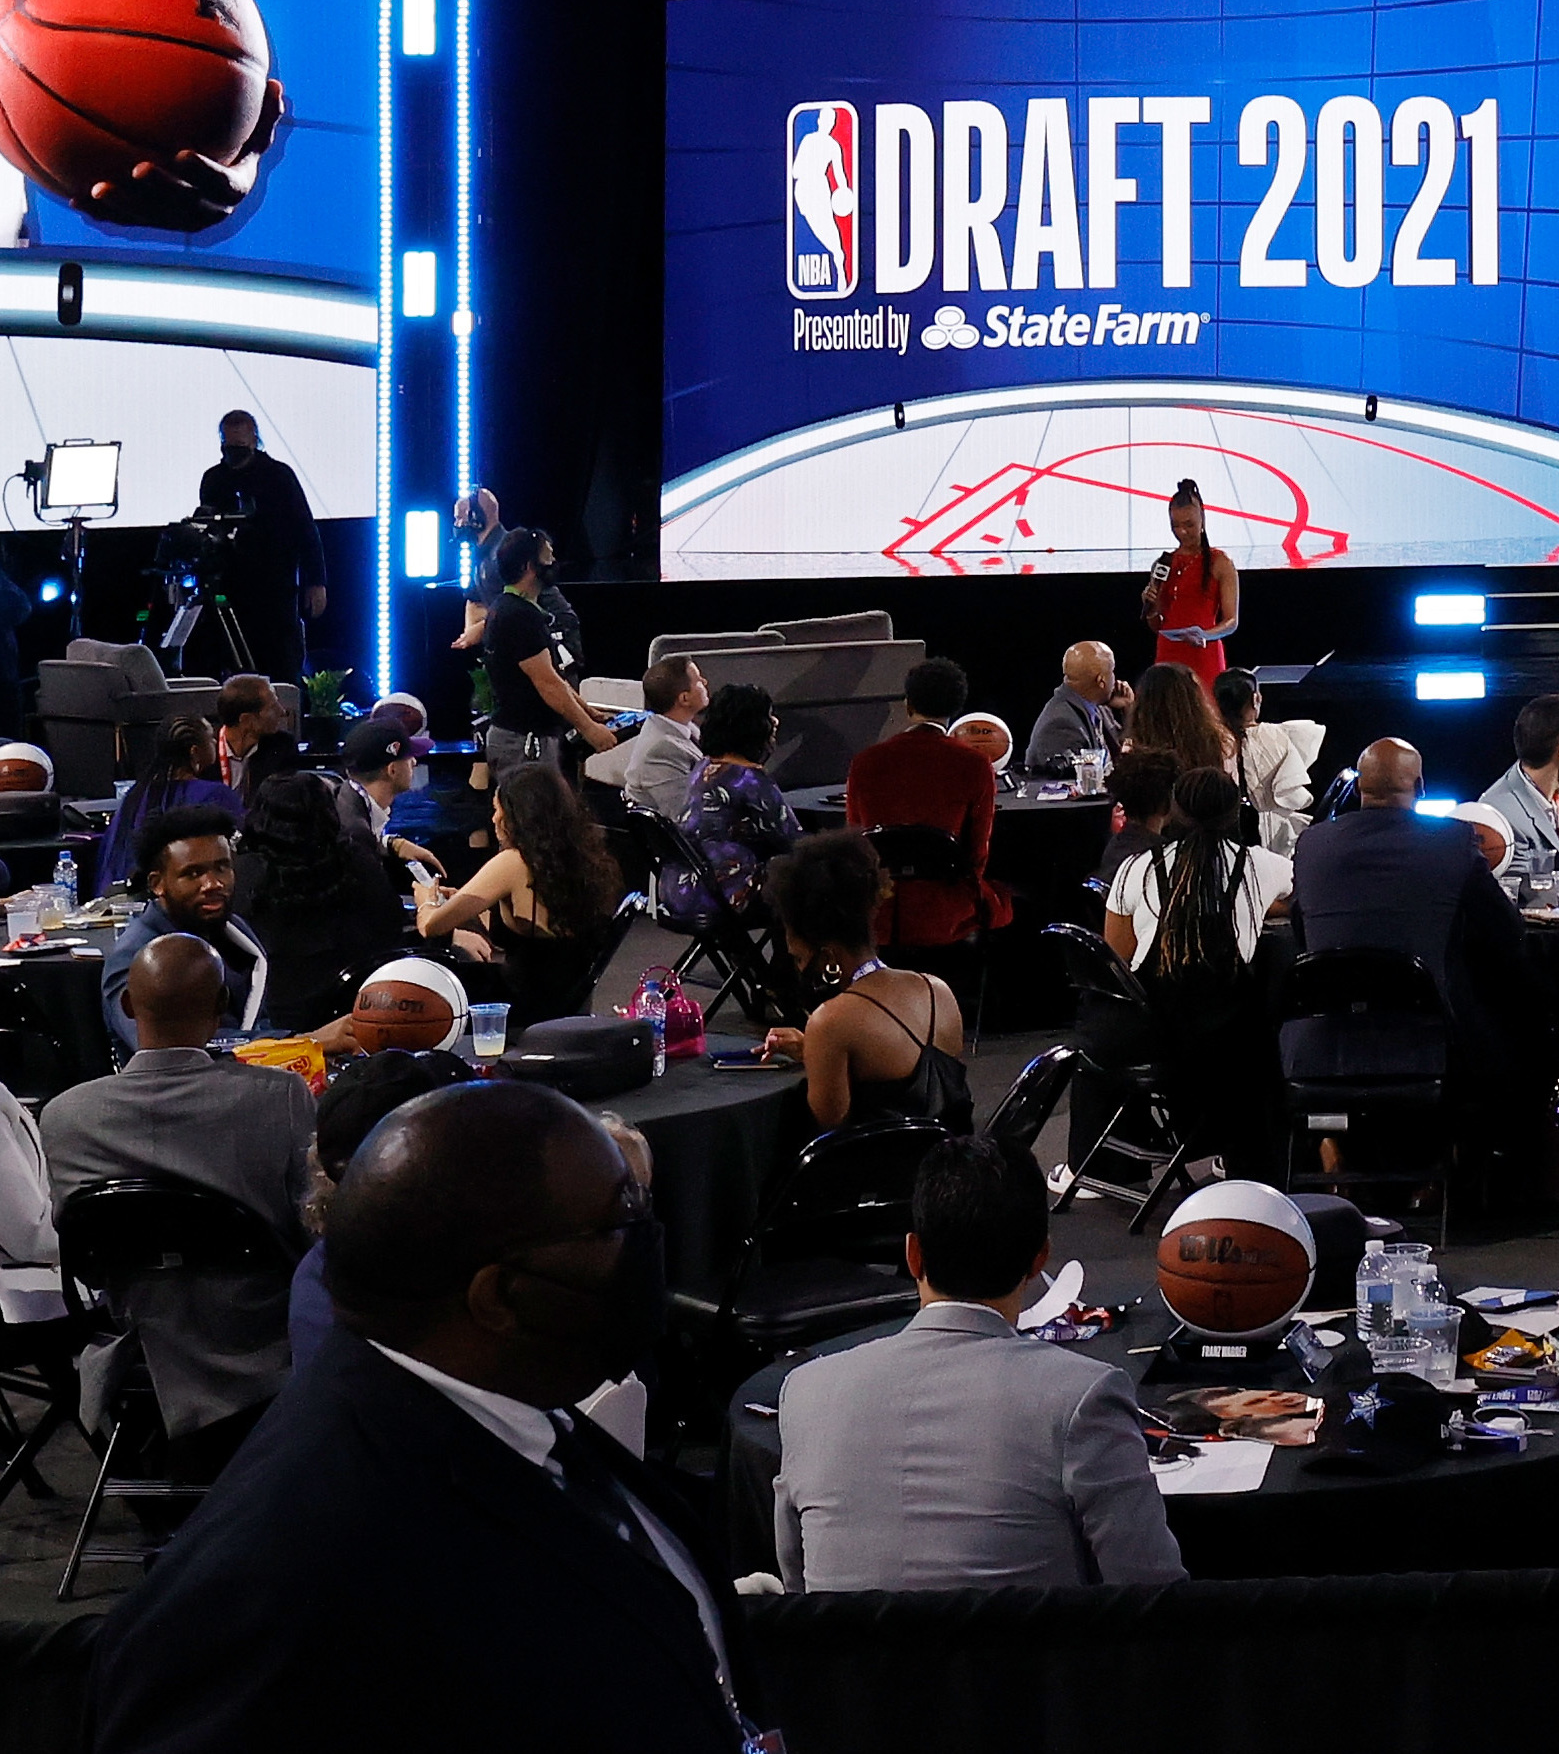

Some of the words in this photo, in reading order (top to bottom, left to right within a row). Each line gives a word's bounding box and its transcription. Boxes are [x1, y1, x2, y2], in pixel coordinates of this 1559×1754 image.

[875, 97, 1210, 292] DRAFT
[1238, 95, 1498, 288] 2021
[798, 253, 832, 286] NBA
[794, 306, 883, 351] Presented
[888, 306, 910, 355] by
